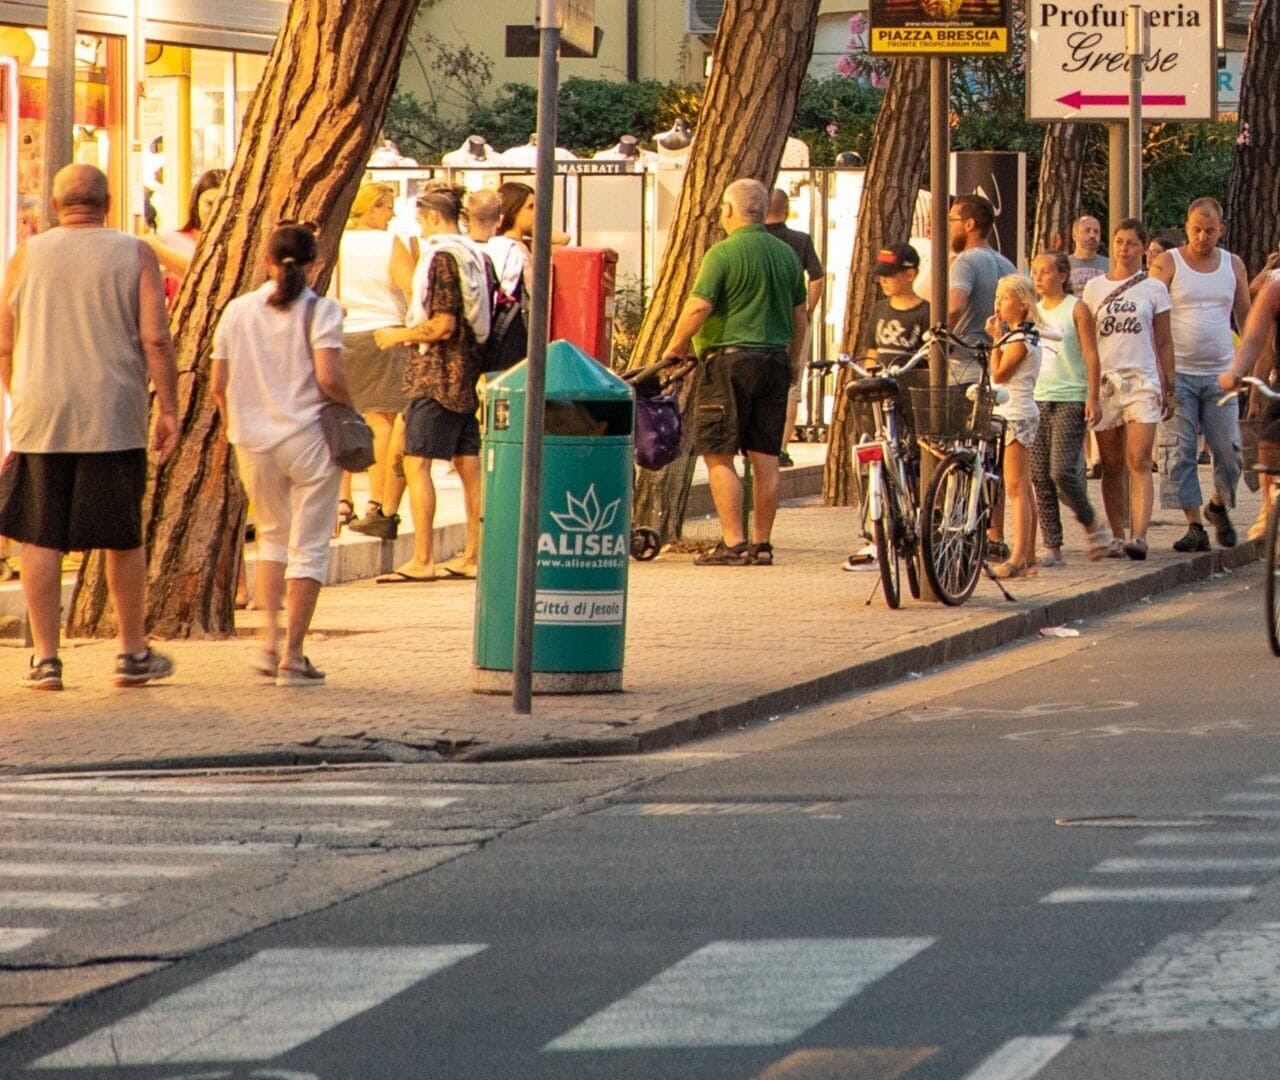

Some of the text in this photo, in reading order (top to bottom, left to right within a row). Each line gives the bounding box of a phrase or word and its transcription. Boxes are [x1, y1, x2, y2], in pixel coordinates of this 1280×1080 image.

[879, 30, 999, 40] PIAZZA BRESCIA
[557, 164, 619, 173] MASERATI
[1101, 316, 1142, 336] Belle
[537, 533, 626, 555] ALISEA
[535, 601, 620, 618] Città di Jesolo
